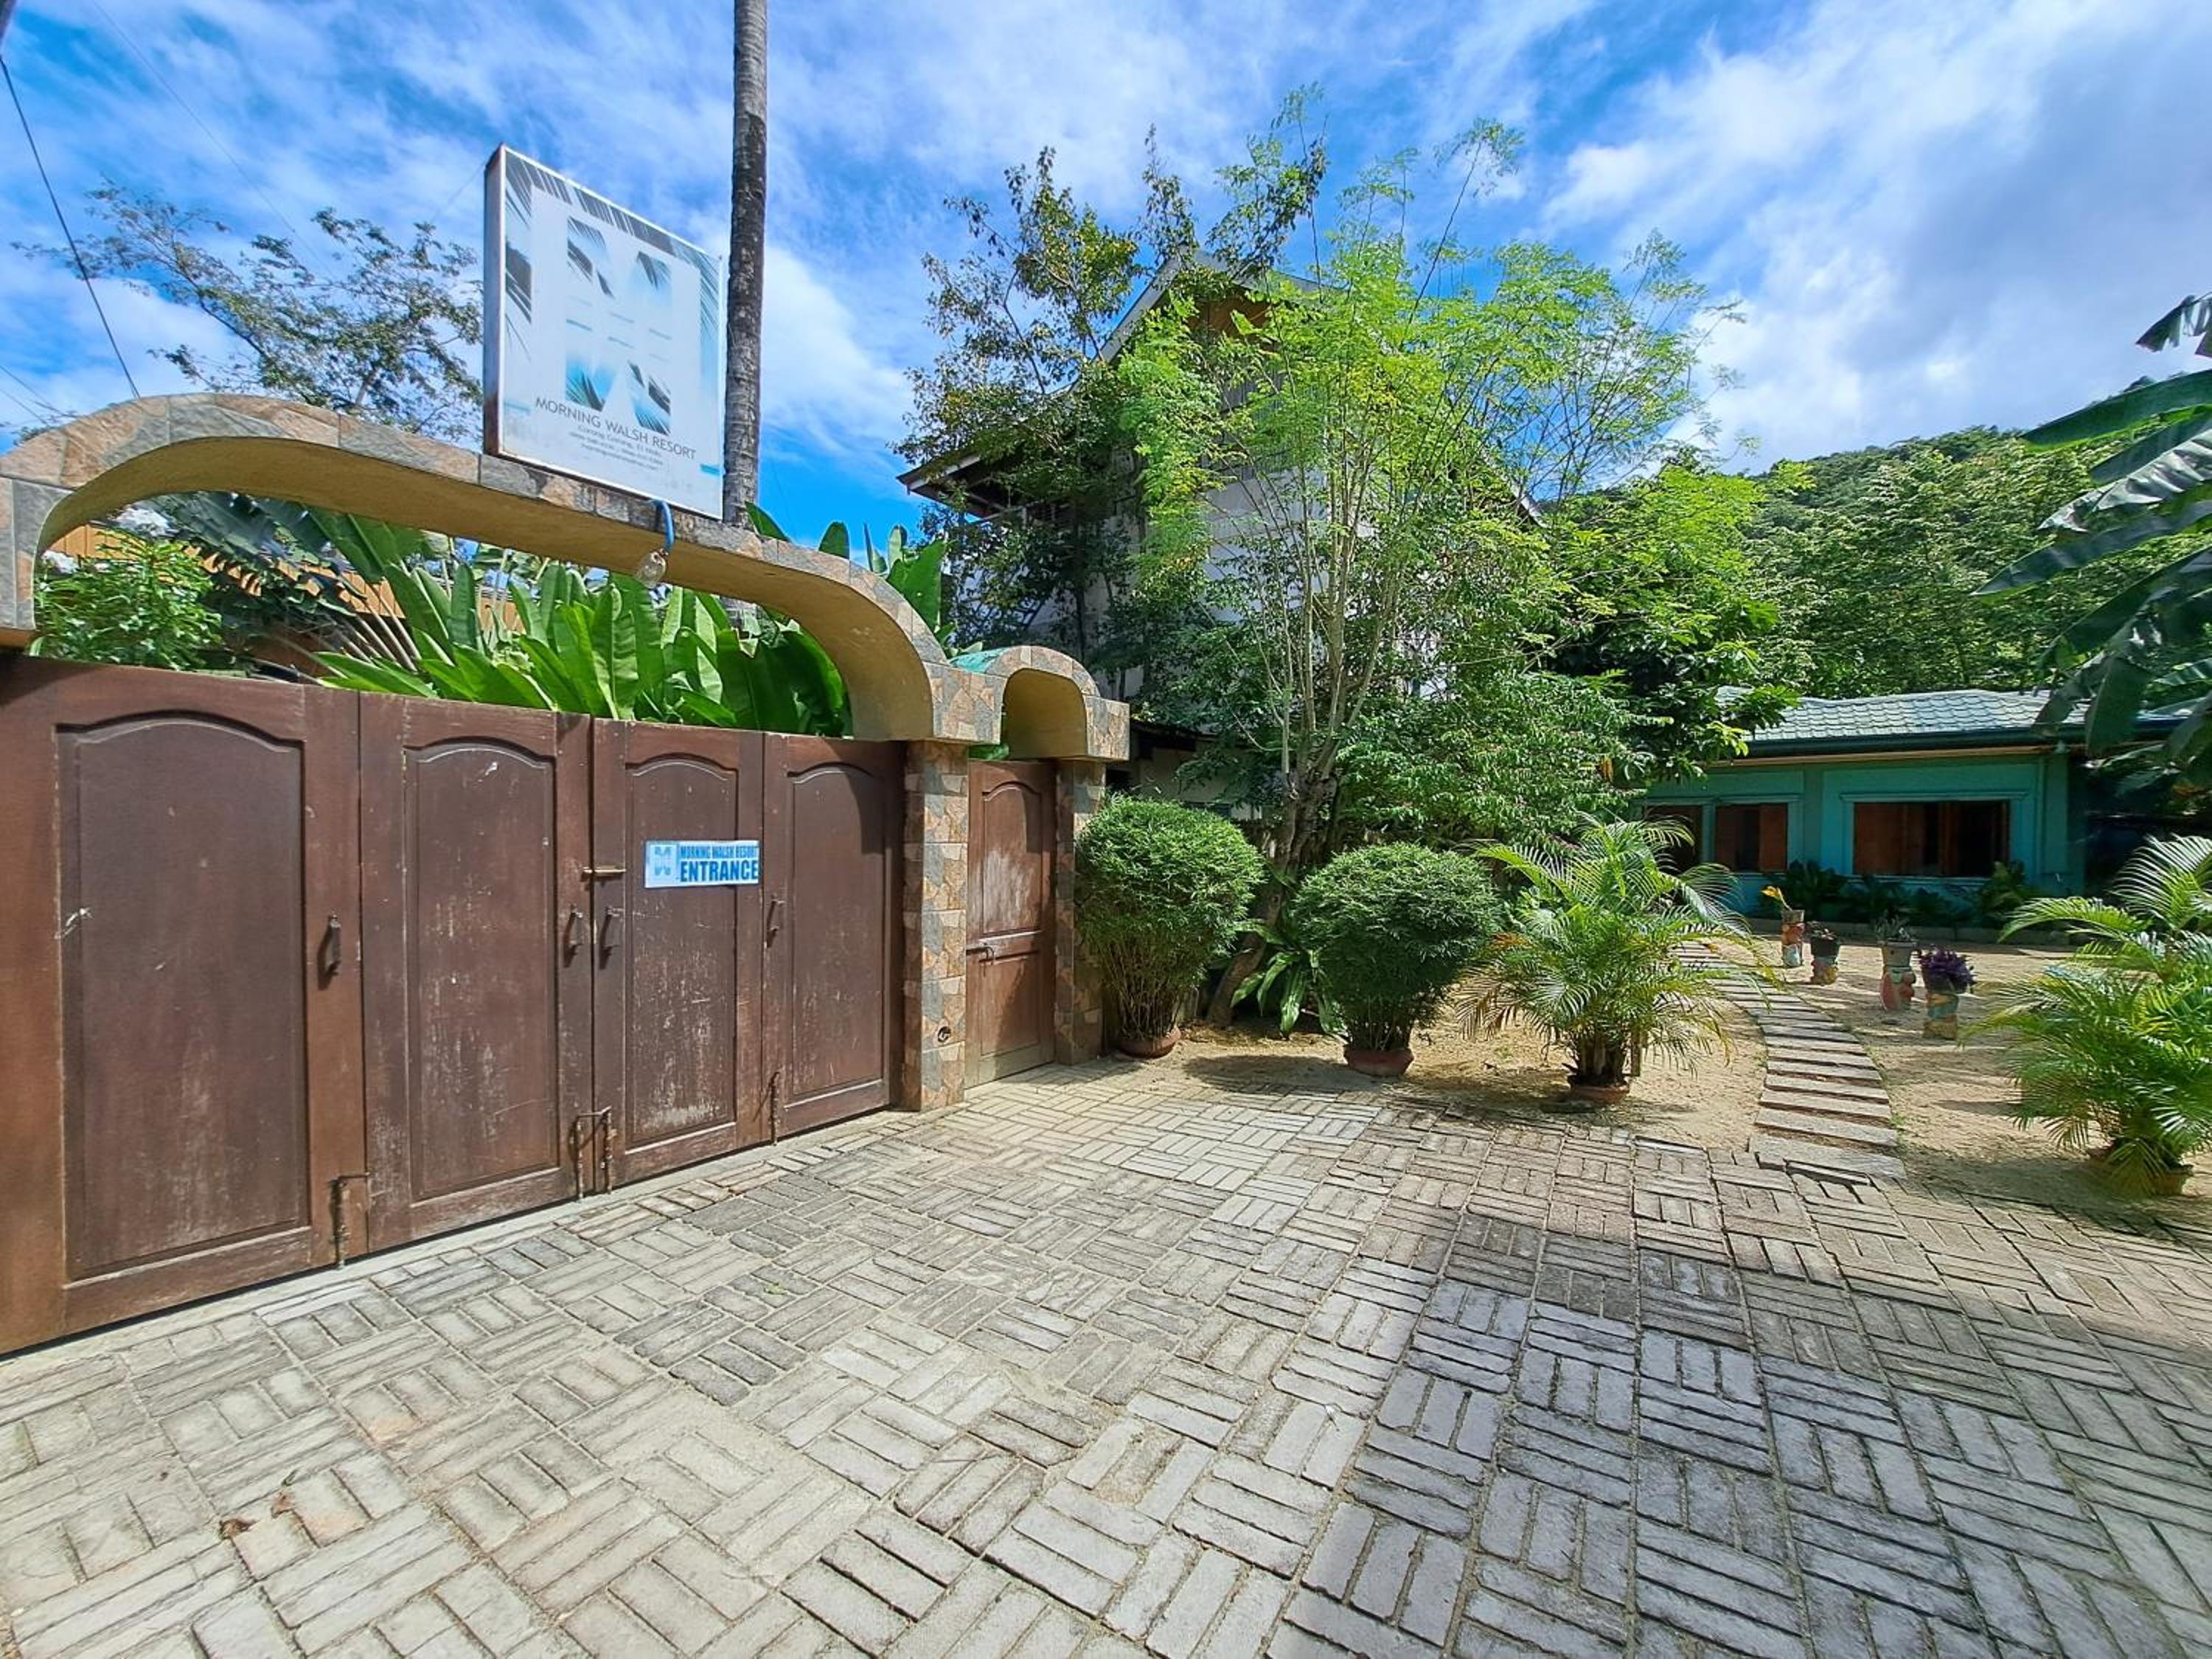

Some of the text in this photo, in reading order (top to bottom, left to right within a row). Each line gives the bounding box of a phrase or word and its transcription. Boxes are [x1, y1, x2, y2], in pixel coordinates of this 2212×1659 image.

[535, 396, 601, 428] MORNING
[605, 419, 648, 444] WALSH
[652, 436, 696, 459] RESORT
[681, 845, 757, 859] MORNING WALSH RESORT
[681, 860, 759, 882] ENTRANCE
